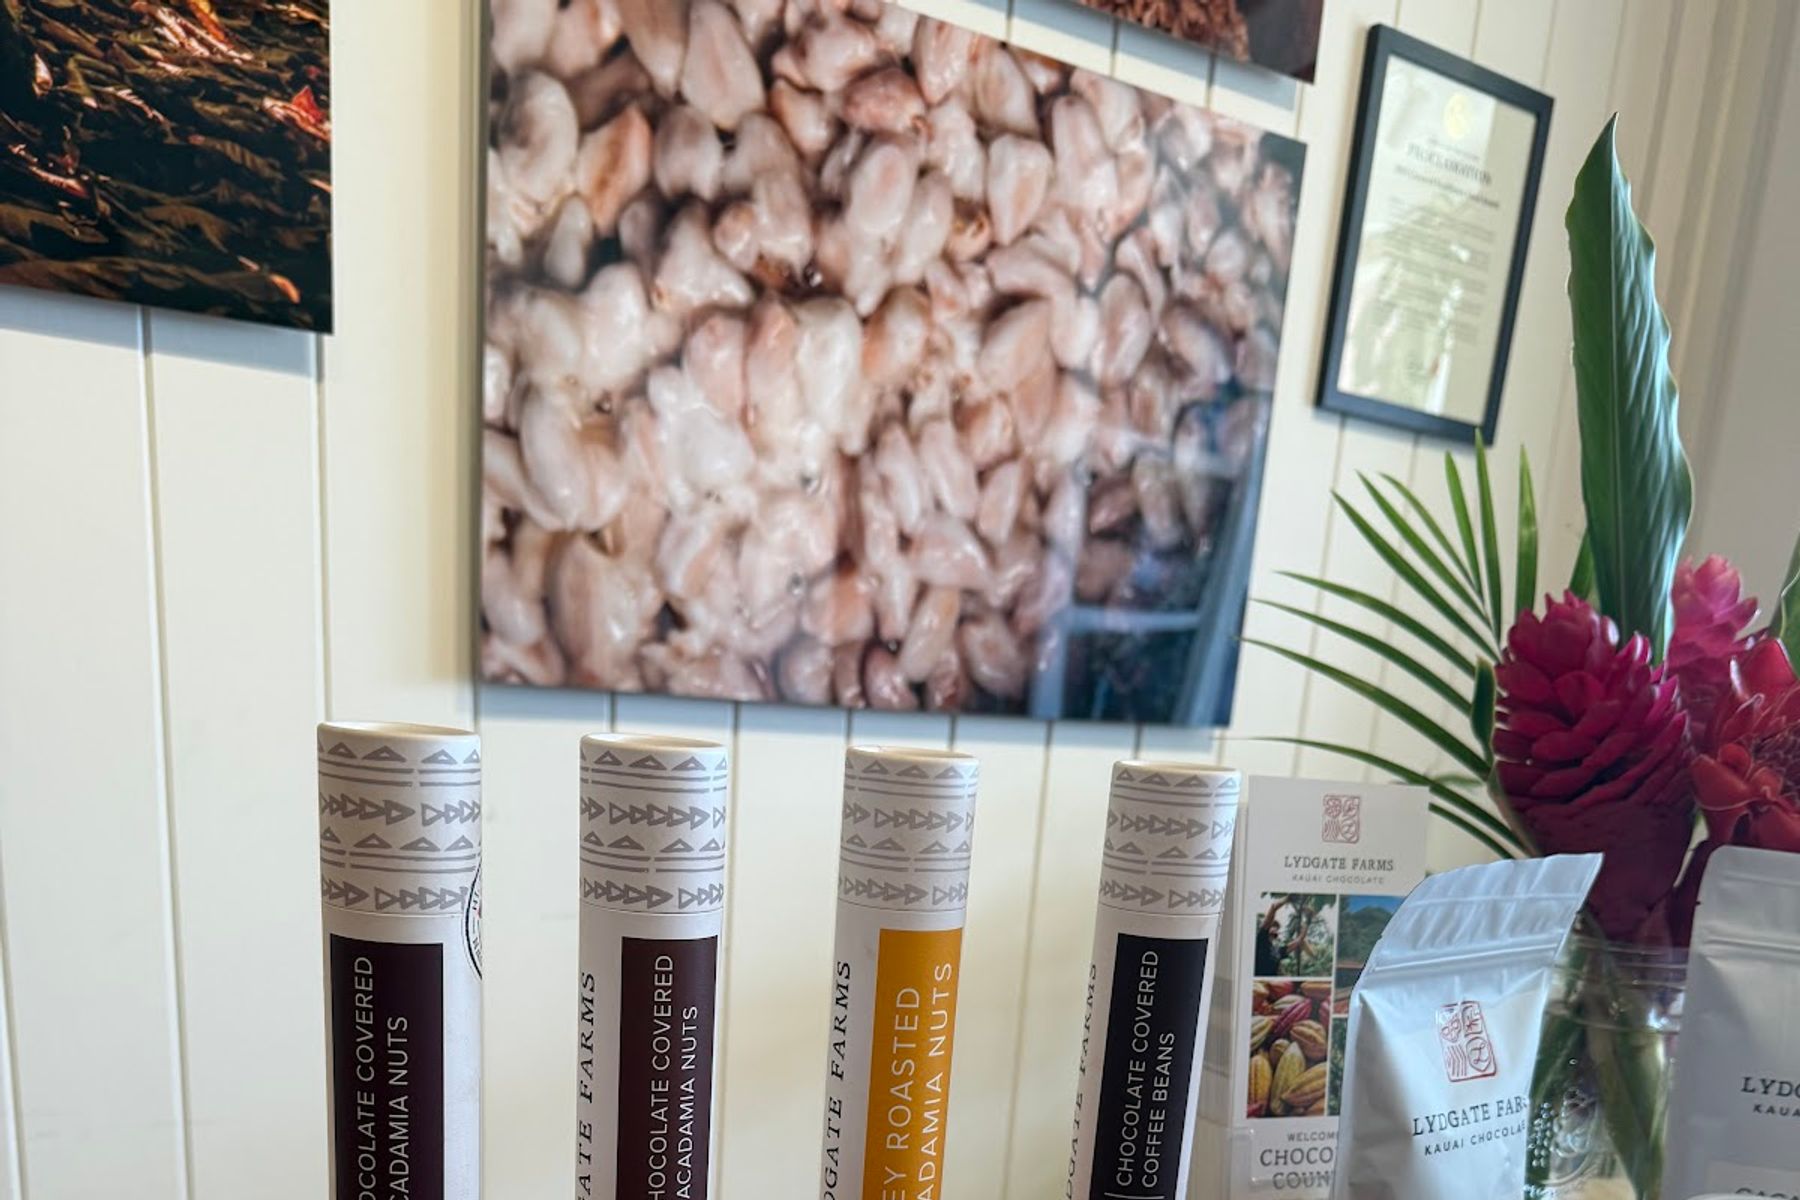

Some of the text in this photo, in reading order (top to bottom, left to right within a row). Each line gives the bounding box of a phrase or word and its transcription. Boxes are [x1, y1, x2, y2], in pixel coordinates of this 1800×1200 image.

[1284, 856, 1394, 872] LYDGATE FARMS
[1292, 875, 1385, 885] KAUAI CHOCOLATE
[354, 956, 374, 1083] COVERED
[580, 972, 595, 1103] FARMS
[652, 955, 673, 1071] COVERED
[681, 1006, 698, 1070] NUTS
[830, 961, 851, 1081] FARMS
[928, 961, 952, 1057] NUTS
[388, 1016, 408, 1086] NUTS
[886, 986, 920, 1151] ROASTED
[1116, 950, 1159, 1186] CHOCOLATE COVERED
[1141, 1032, 1175, 1188] COFFEE BEANS
[1287, 1131, 1339, 1142] WELCOM
[1412, 1103, 1491, 1136] LYDGATE
[1260, 1146, 1336, 1167] CHOCO
[1273, 1170, 1335, 1190] COUN
[1424, 1139, 1464, 1156] KAUAI
